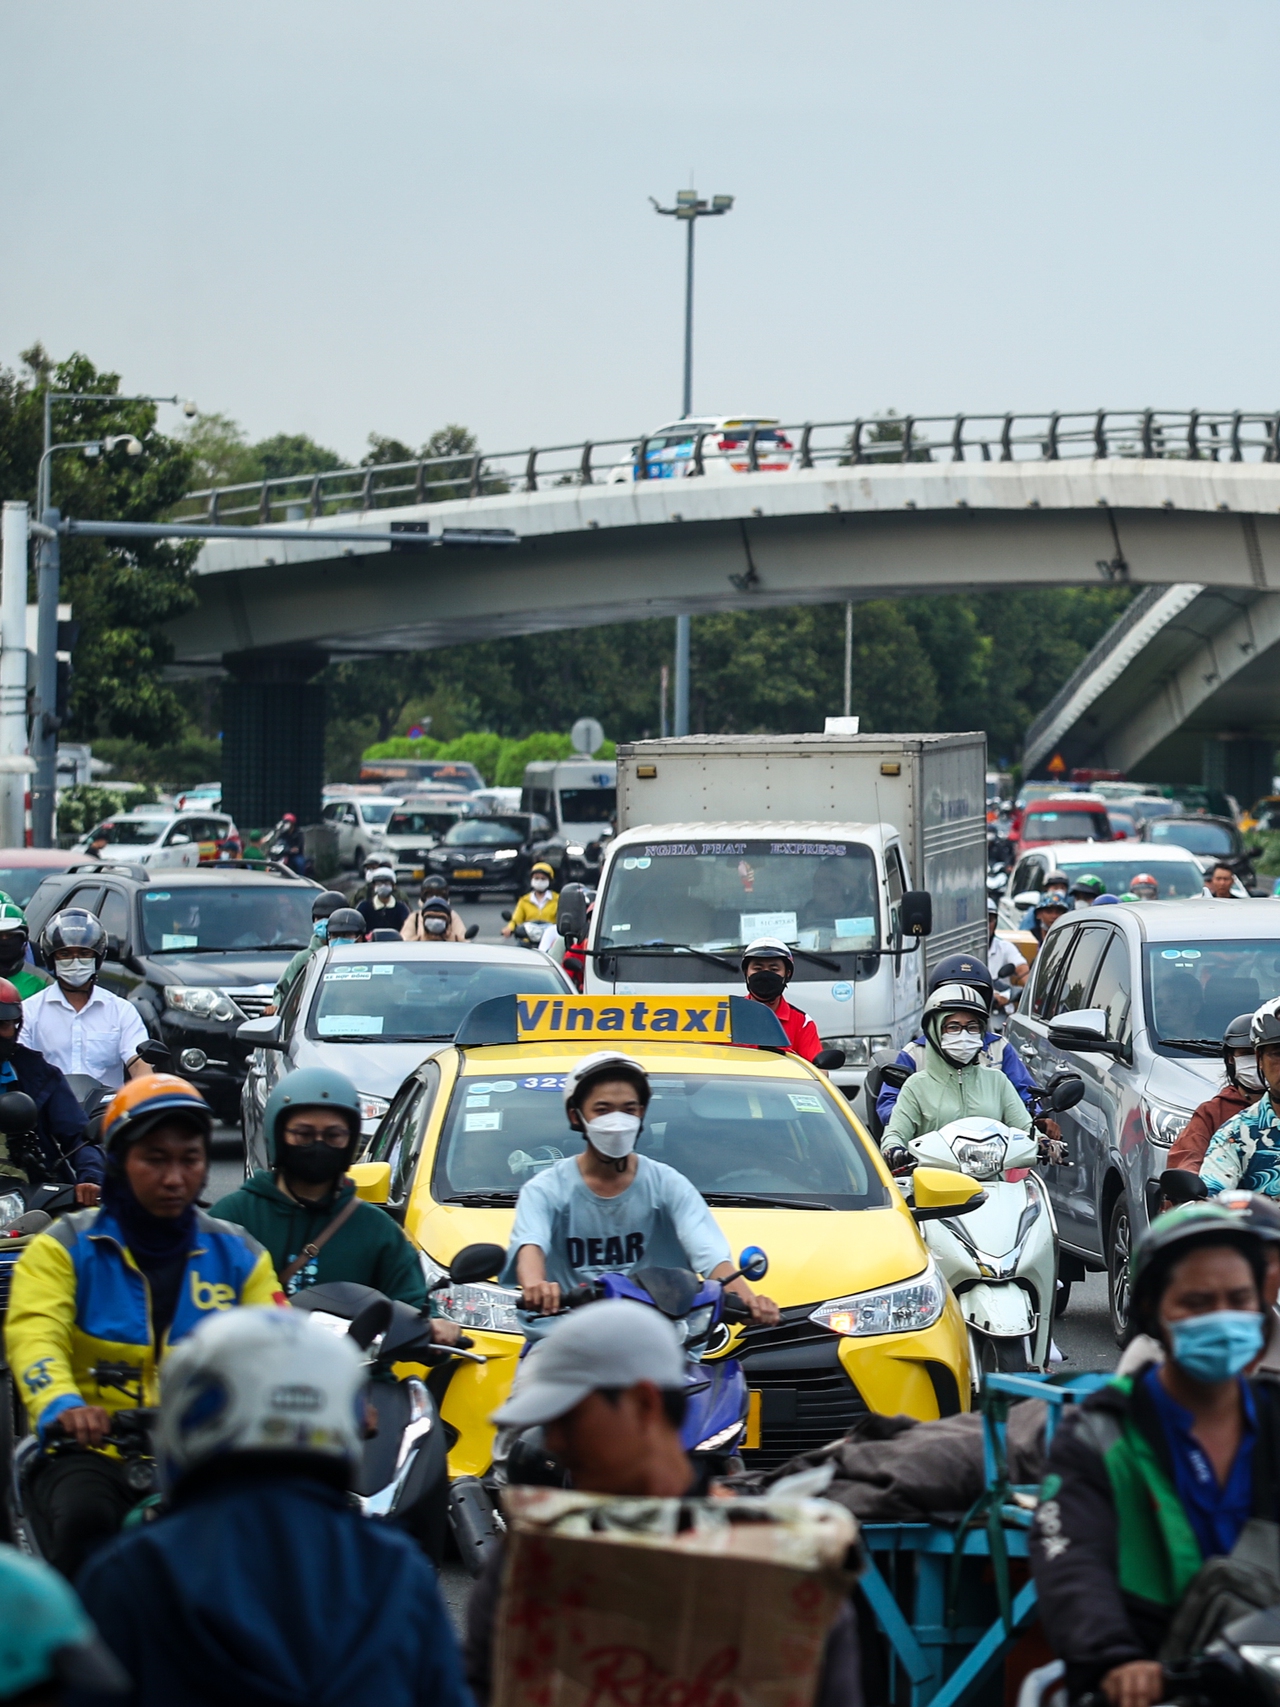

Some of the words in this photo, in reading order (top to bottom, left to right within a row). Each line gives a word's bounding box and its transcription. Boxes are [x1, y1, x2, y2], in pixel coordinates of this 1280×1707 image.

[770, 842, 847, 856] EXPRESS
[517, 1000, 729, 1032] Vinataxi
[566, 1231, 645, 1269] DEAR
[189, 1270, 237, 1311] be
